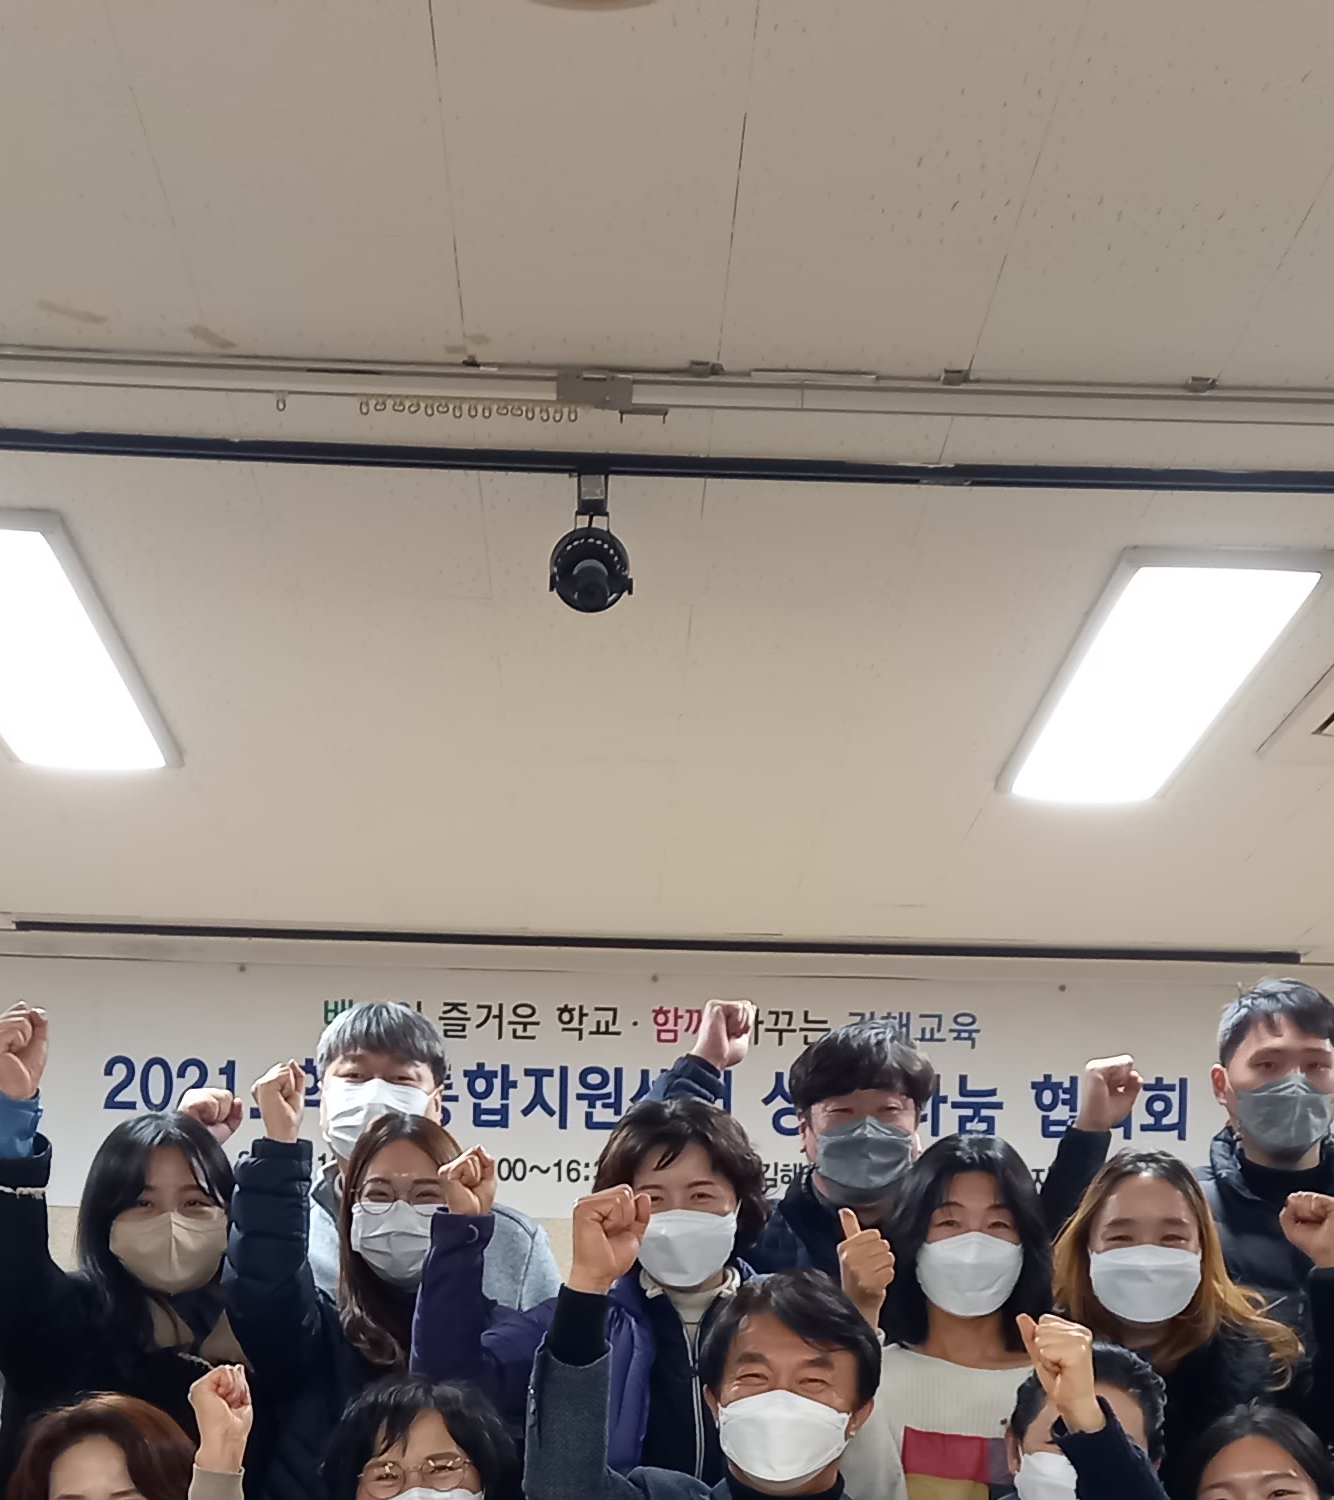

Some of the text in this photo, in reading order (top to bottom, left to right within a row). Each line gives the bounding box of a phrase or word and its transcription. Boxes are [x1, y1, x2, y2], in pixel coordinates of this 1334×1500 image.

[438, 1001, 541, 1040] 즐거운
[556, 1004, 622, 1041] 학교
[753, 1008, 831, 1046] 꾸는
[1030, 1074, 1188, 1141] 협회
